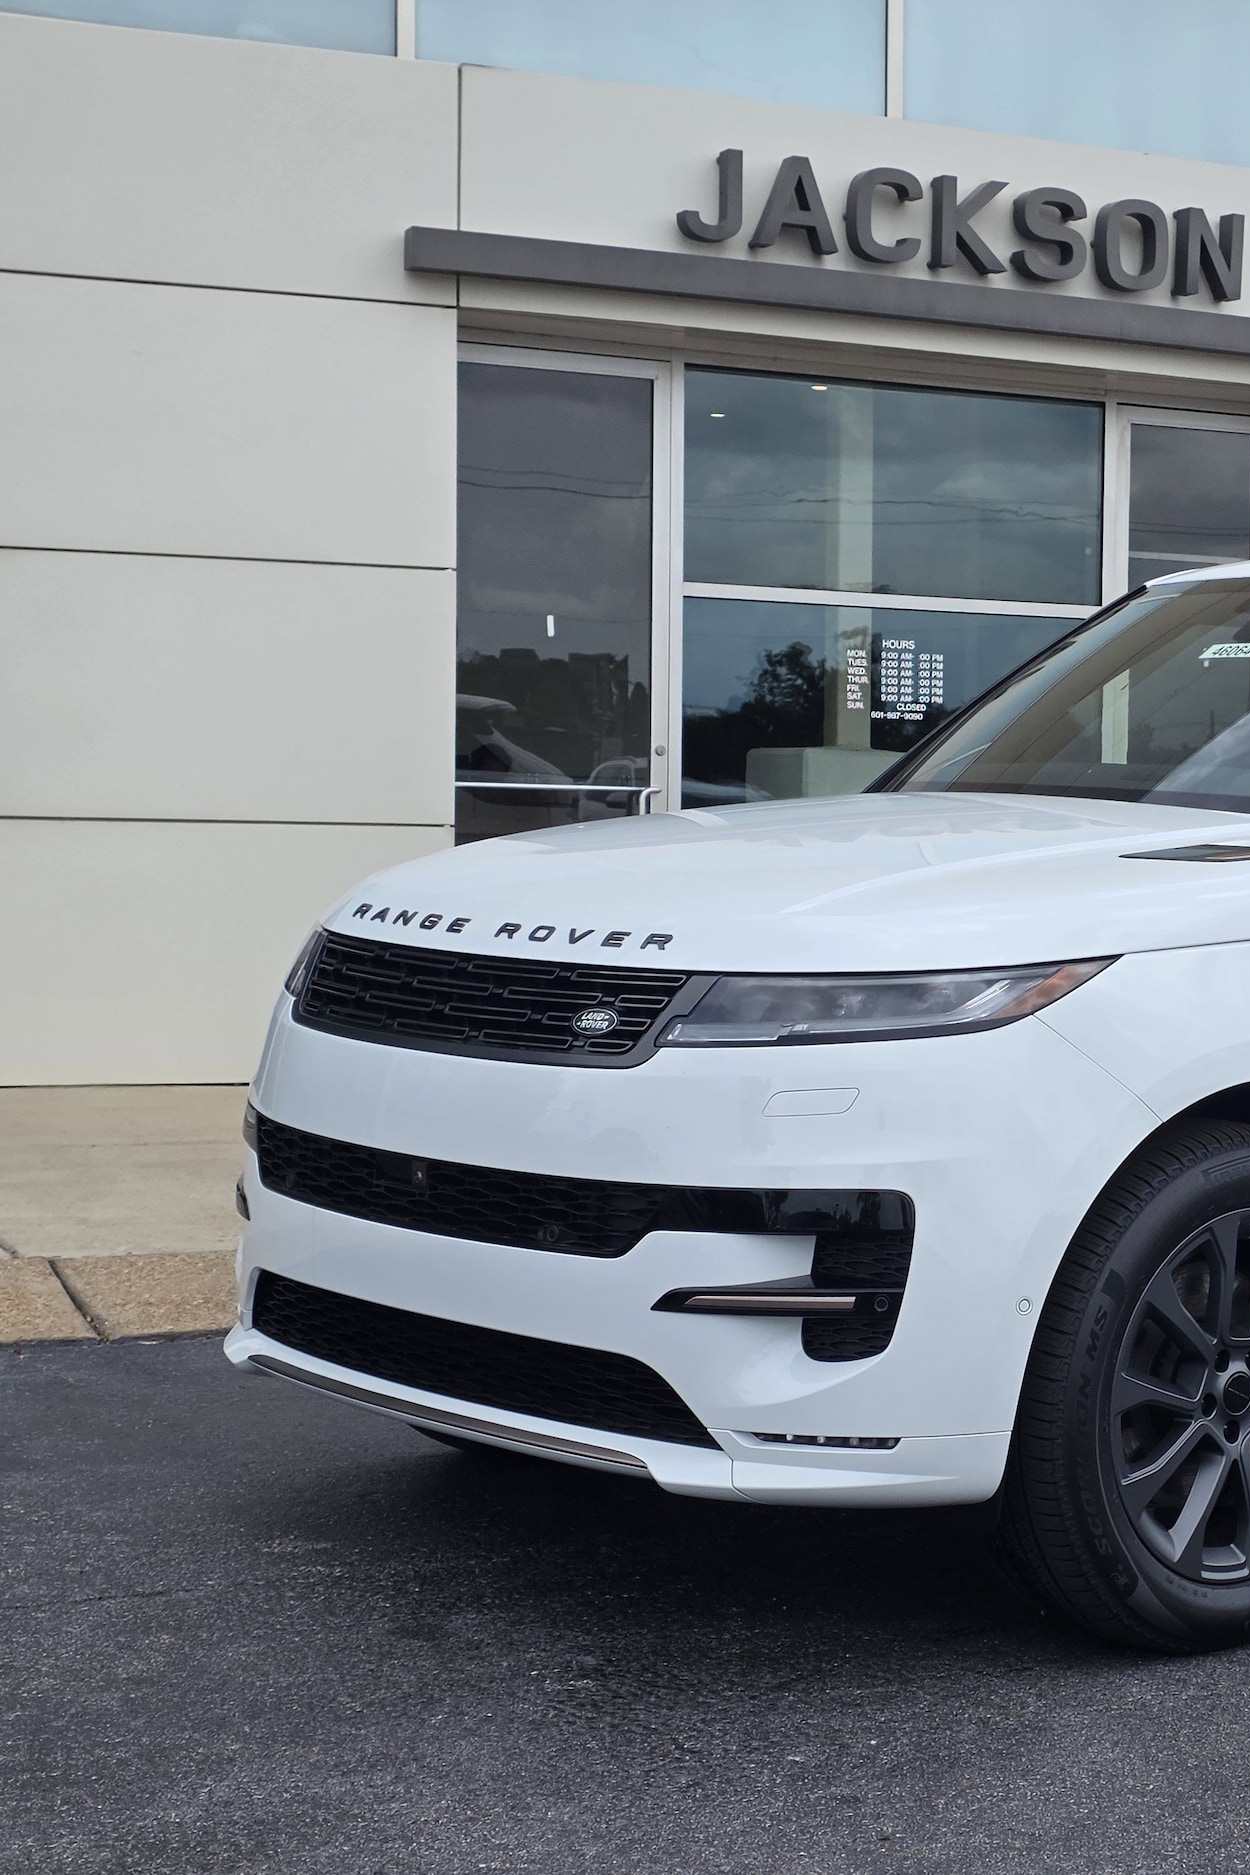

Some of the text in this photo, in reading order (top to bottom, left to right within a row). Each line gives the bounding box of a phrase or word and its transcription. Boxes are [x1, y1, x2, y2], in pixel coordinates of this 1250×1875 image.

[676, 148, 1245, 302] JACKSON
[882, 640, 915, 650] HOURS
[896, 703, 926, 711] CLOSED
[352, 903, 674, 950] RANGE ROVER
[580, 1012, 606, 1020] LAND
[580, 1020, 609, 1030] ROVER
